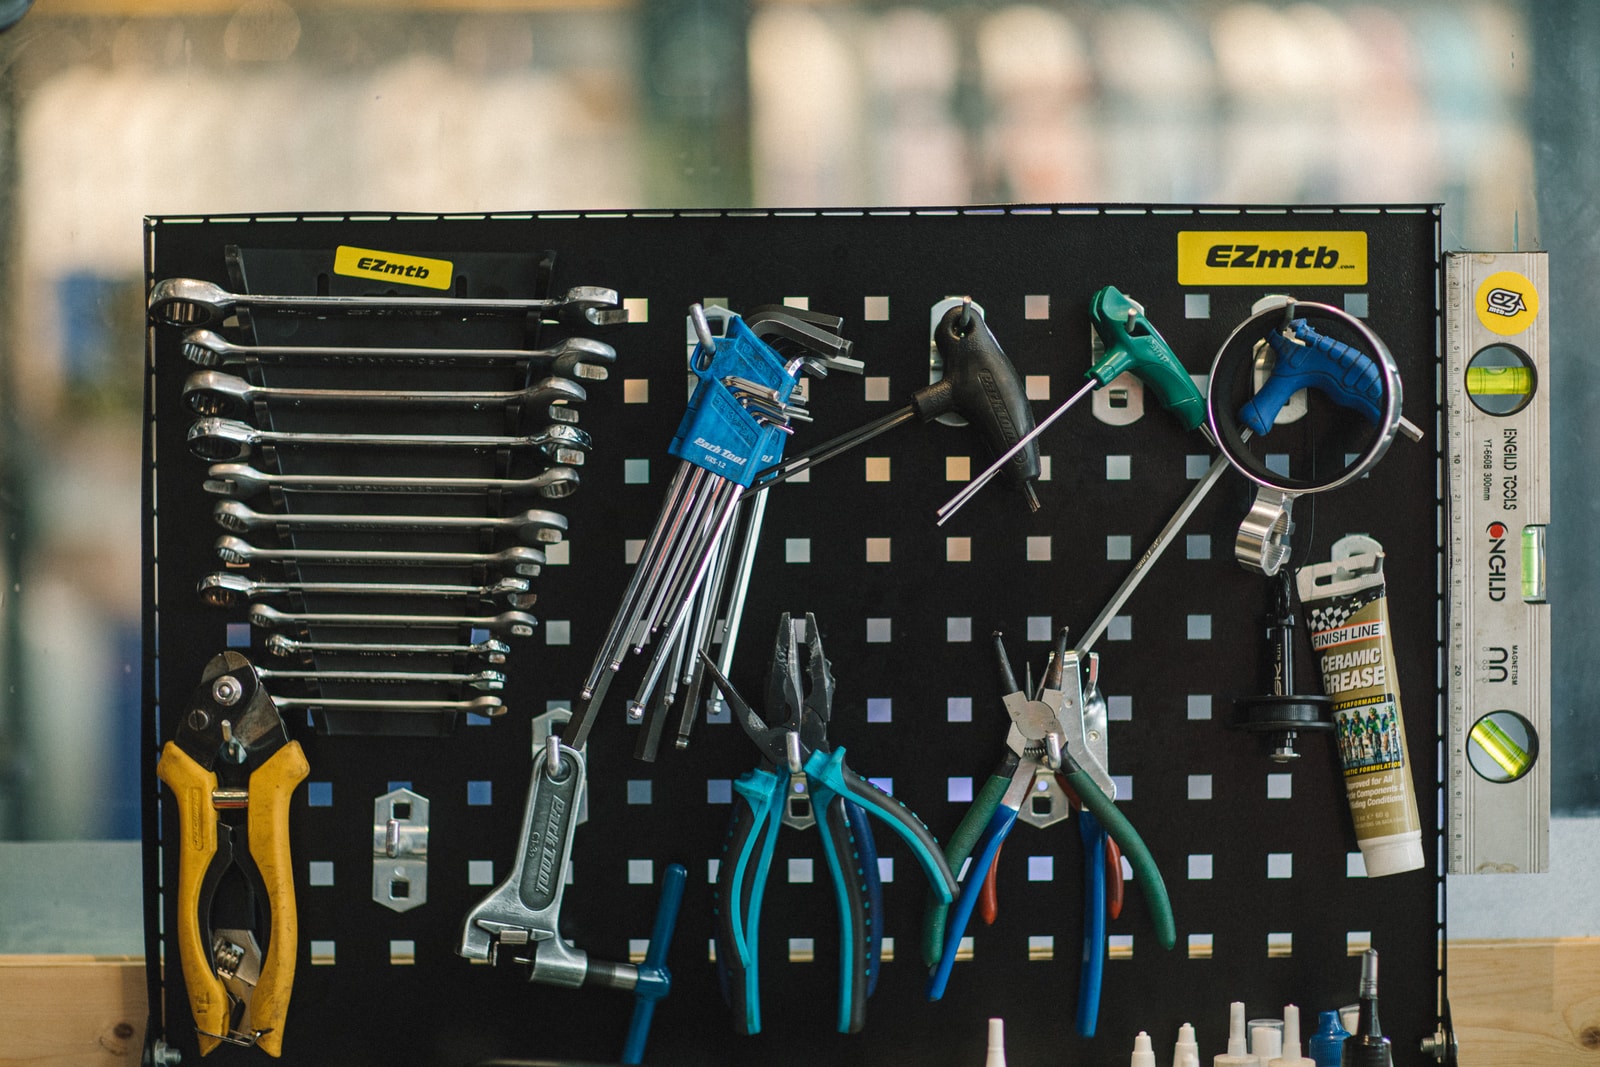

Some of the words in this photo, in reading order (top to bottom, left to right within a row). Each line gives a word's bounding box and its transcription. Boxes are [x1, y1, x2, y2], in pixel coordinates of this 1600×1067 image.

[357, 257, 430, 279] EZmtb
[693, 437, 721, 454] Park
[720, 449, 748, 465] Tool
[1454, 453, 1460, 464] 10
[1483, 439, 1493, 470] YT-660B
[1503, 428, 1518, 471] ENGILD
[1483, 472, 1493, 502] 300mm
[1503, 475, 1518, 511] TOOLS
[1313, 631, 1348, 649] FINISH
[1351, 623, 1380, 639] LINE
[1321, 647, 1381, 674] CERAMIC
[1455, 665, 1462, 677] 20
[1511, 645, 1519, 686] MAGNETISM
[1323, 665, 1386, 695] GREASE
[1340, 695, 1385, 709] PERFORMANCE
[1359, 760, 1402, 773] FORMULATION
[1356, 784, 1399, 798] Components
[1371, 776, 1381, 786] for
[1383, 774, 1393, 783] All
[1367, 794, 1404, 807] Conditions
